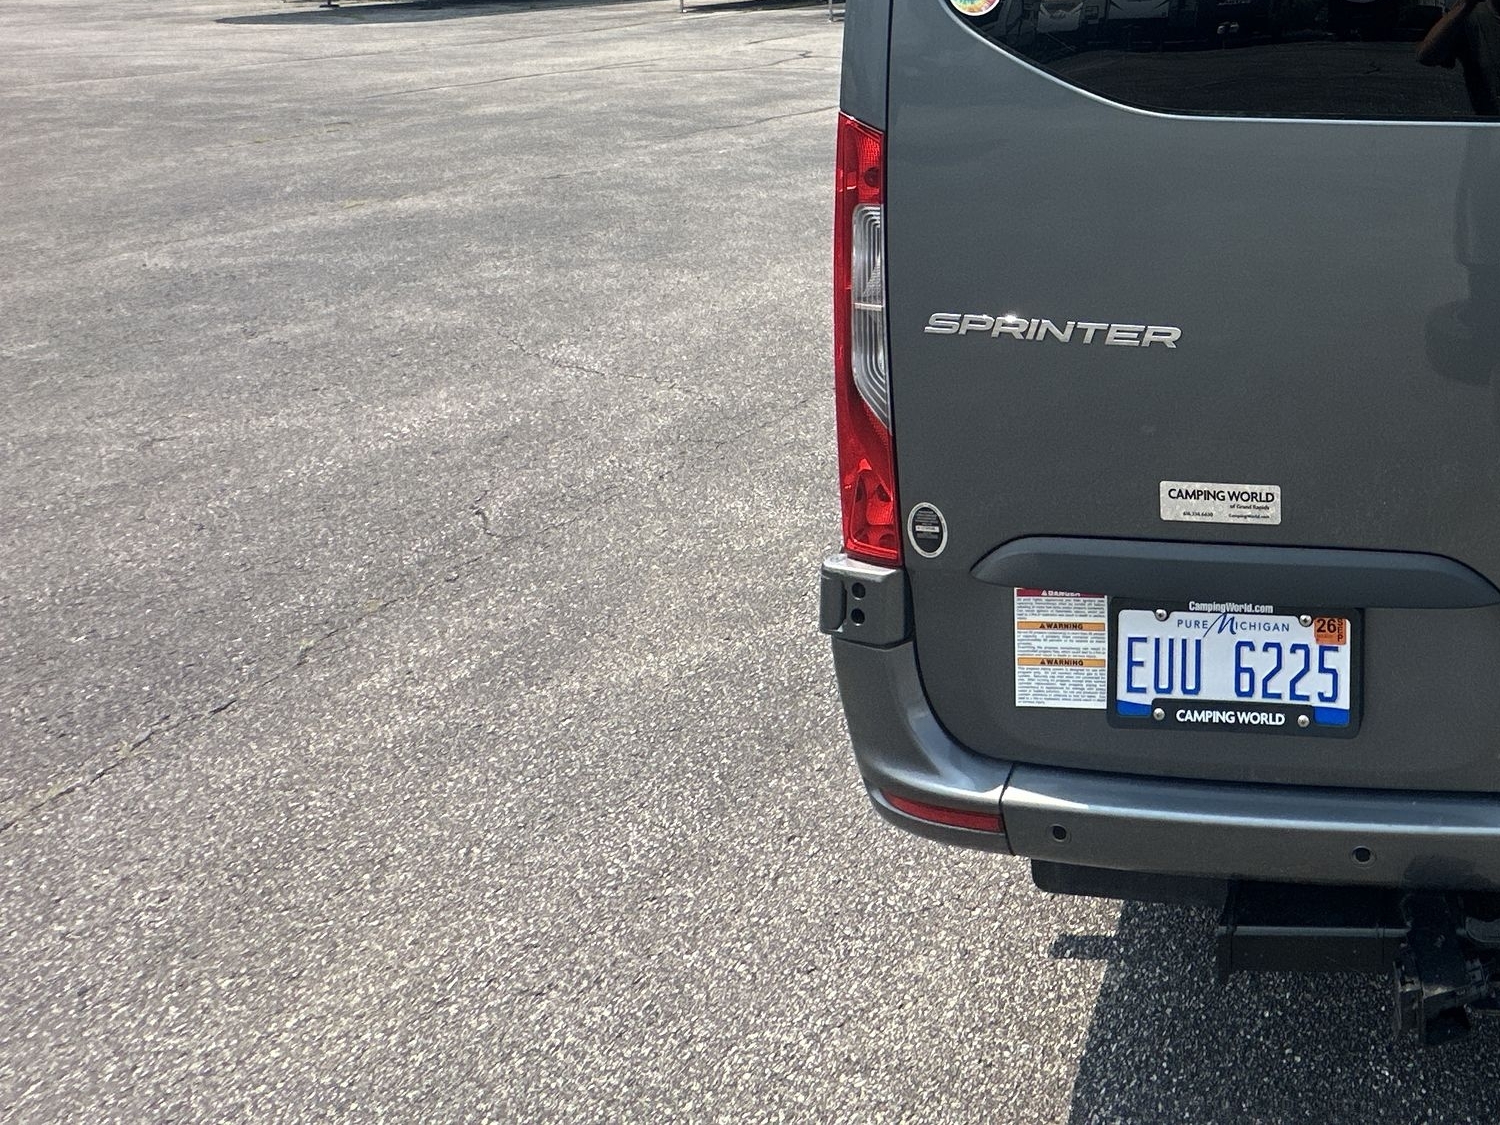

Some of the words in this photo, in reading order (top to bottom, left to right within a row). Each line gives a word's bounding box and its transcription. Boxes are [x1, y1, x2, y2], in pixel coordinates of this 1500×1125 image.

[924, 312, 1183, 349] SPRINTER
[1168, 488, 1226, 501] CAMPING
[1227, 491, 1275, 503] WORLD
[1188, 601, 1274, 614] CampingWorld.com
[1177, 619, 1208, 629] PURE
[1203, 612, 1290, 638] MICHIGAN
[1316, 618, 1336, 633] 26
[1047, 658, 1084, 666] WARNING
[1126, 636, 1202, 695] EUU
[1234, 640, 1340, 703] 6225
[1176, 709, 1235, 724] CAMPING
[1236, 711, 1286, 726] WORLD
